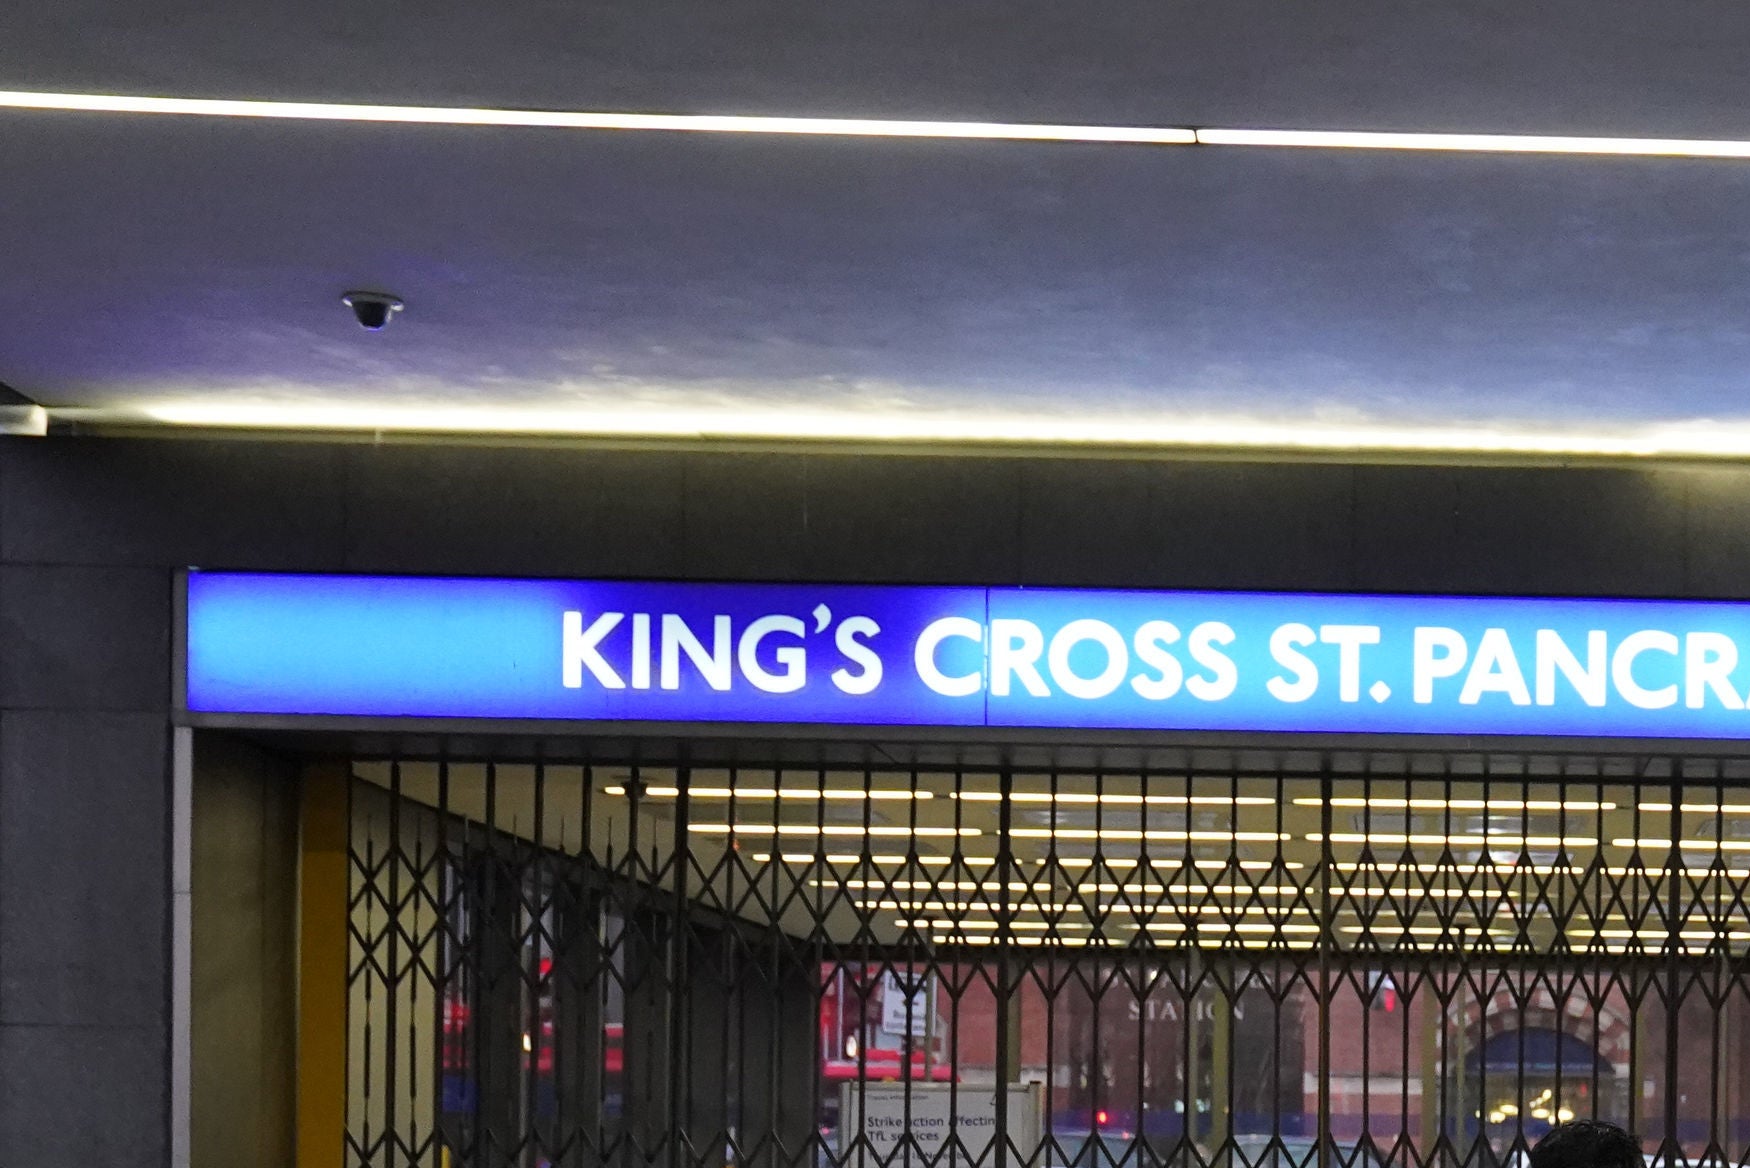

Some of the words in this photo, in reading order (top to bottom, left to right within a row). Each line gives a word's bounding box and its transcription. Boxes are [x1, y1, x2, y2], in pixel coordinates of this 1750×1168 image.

[562, 604, 883, 695] KING'S
[914, 617, 1238, 701] CROSS
[1266, 623, 1391, 703] ST.
[867, 1116, 903, 1128] Strike
[906, 1116, 944, 1128] ction
[868, 1131, 887, 1142] TfL
[891, 1131, 940, 1142] seices
